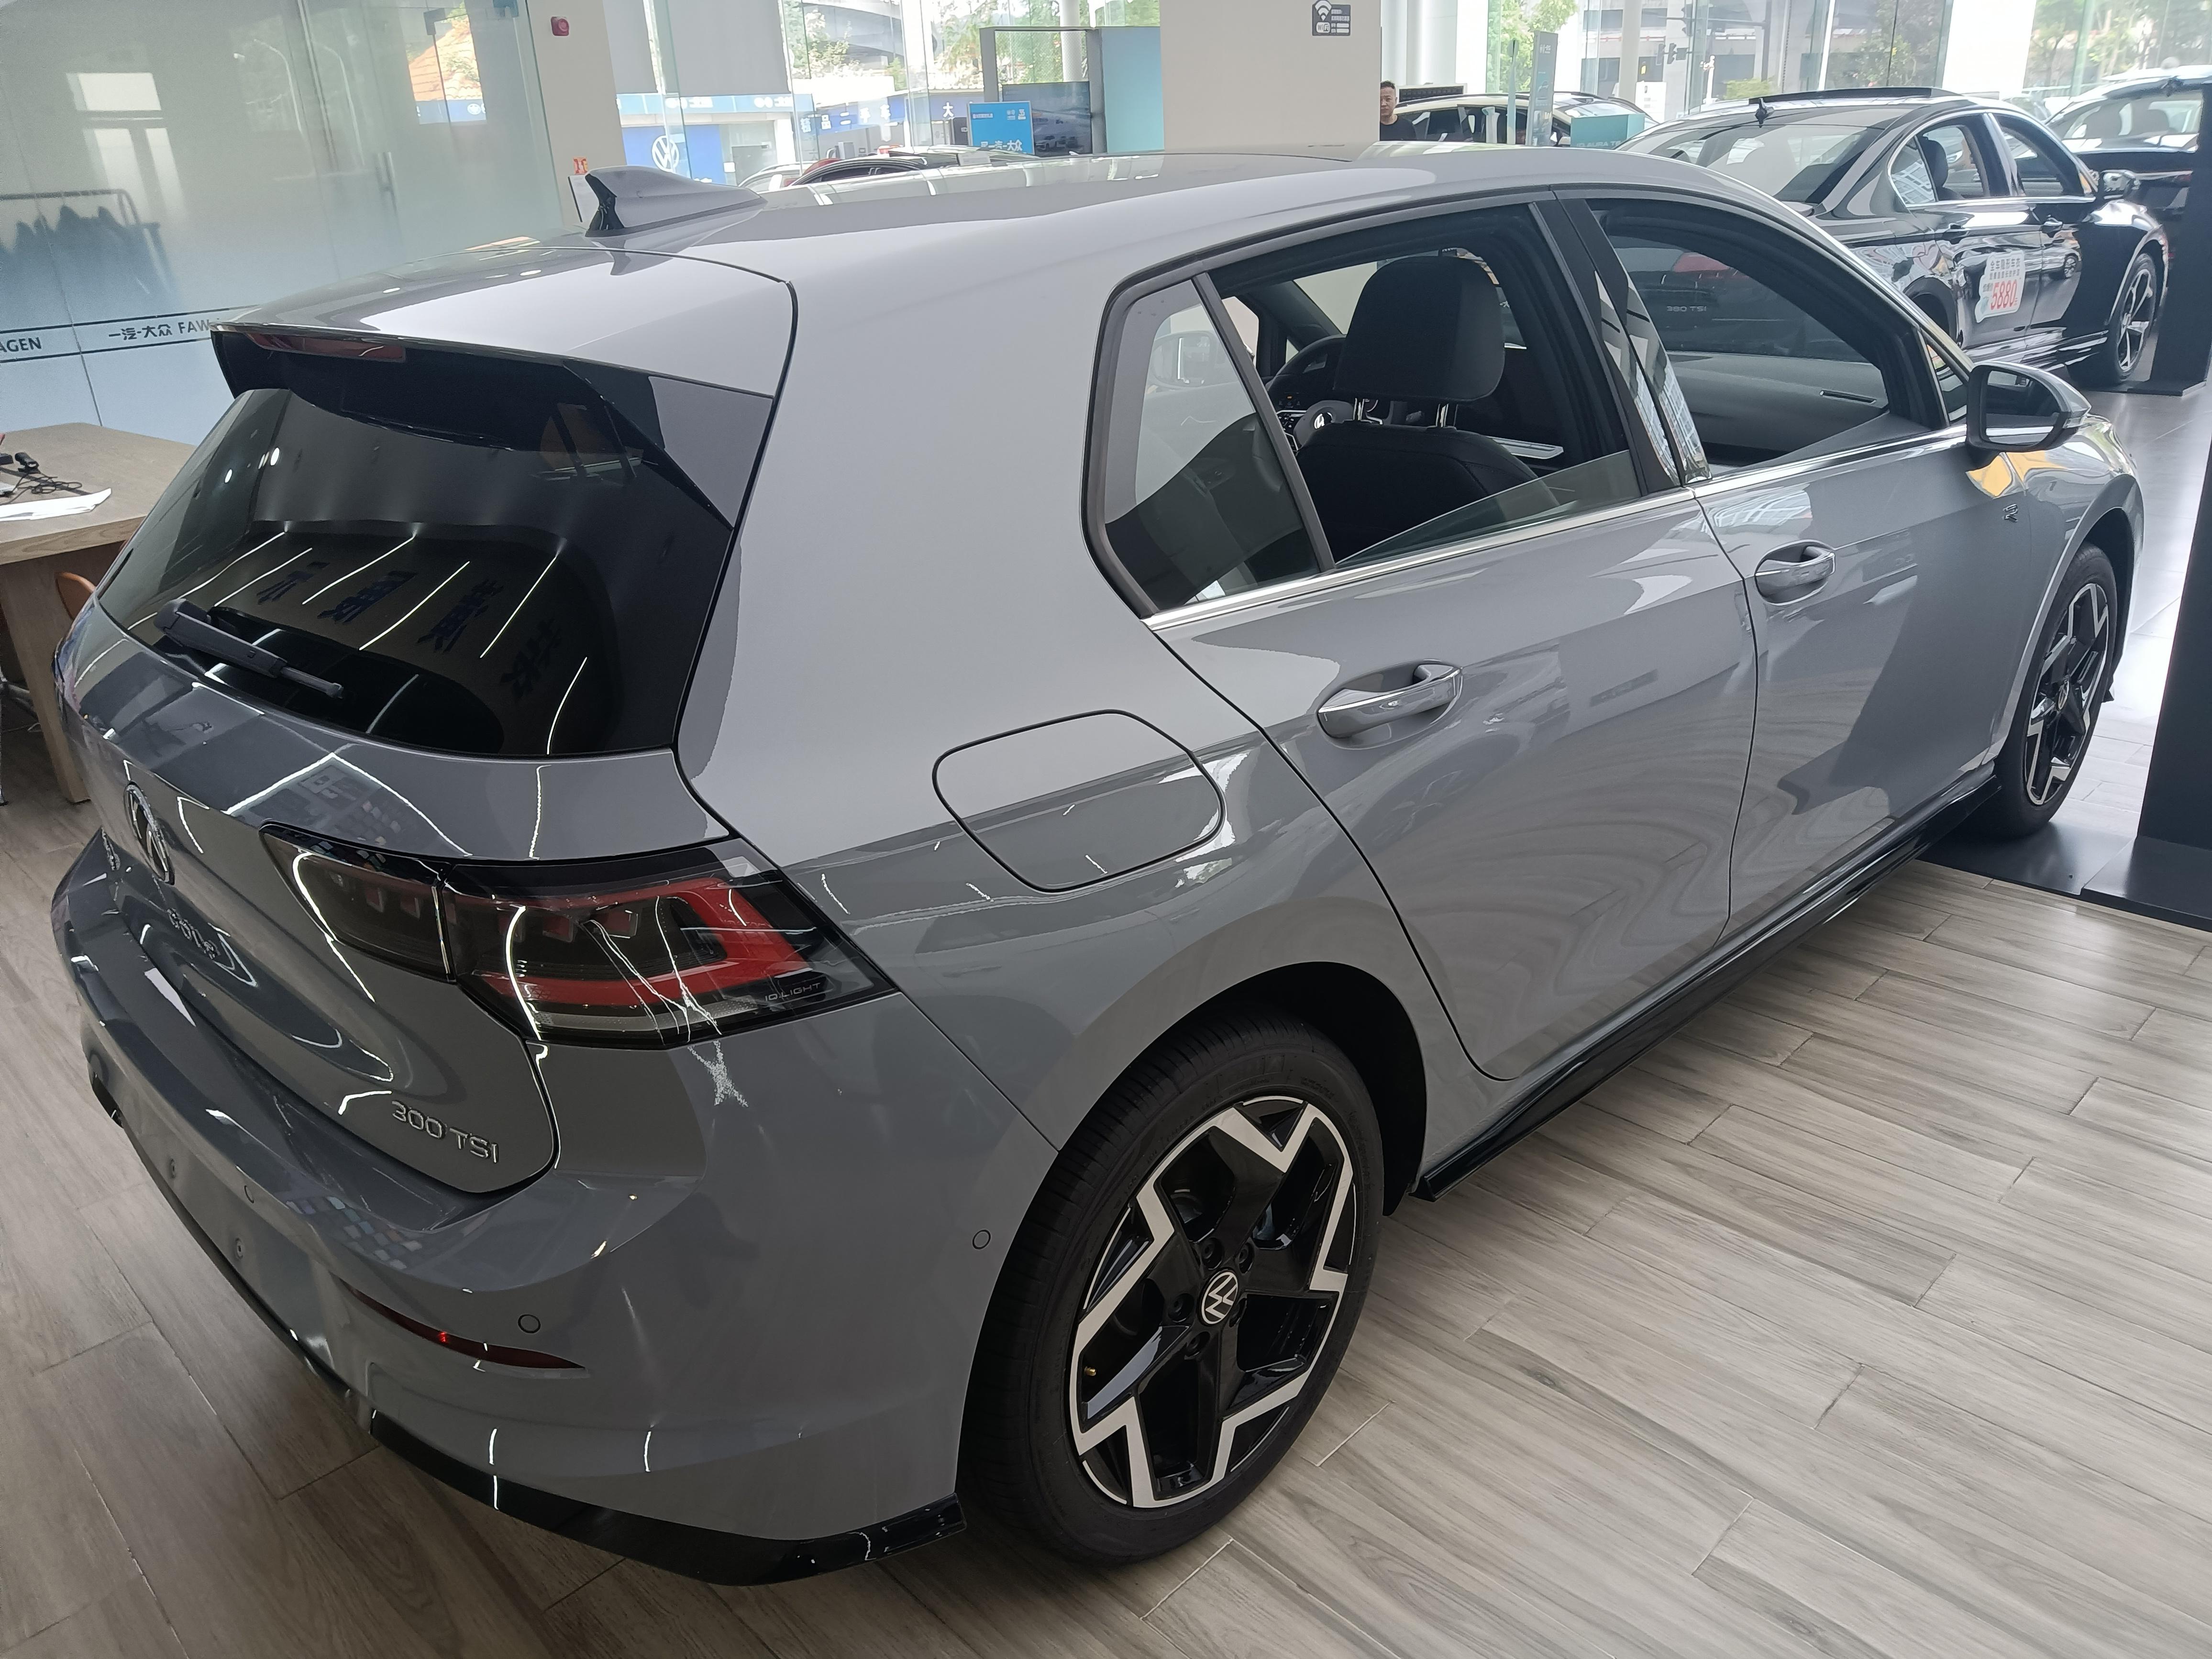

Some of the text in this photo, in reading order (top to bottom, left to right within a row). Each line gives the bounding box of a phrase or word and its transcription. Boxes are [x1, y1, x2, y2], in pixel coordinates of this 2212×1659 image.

[1991, 279, 2017, 310] 5880
[109, 324, 173, 340] 一汽-大众
[392, 1101, 499, 1163] 300 TSI
